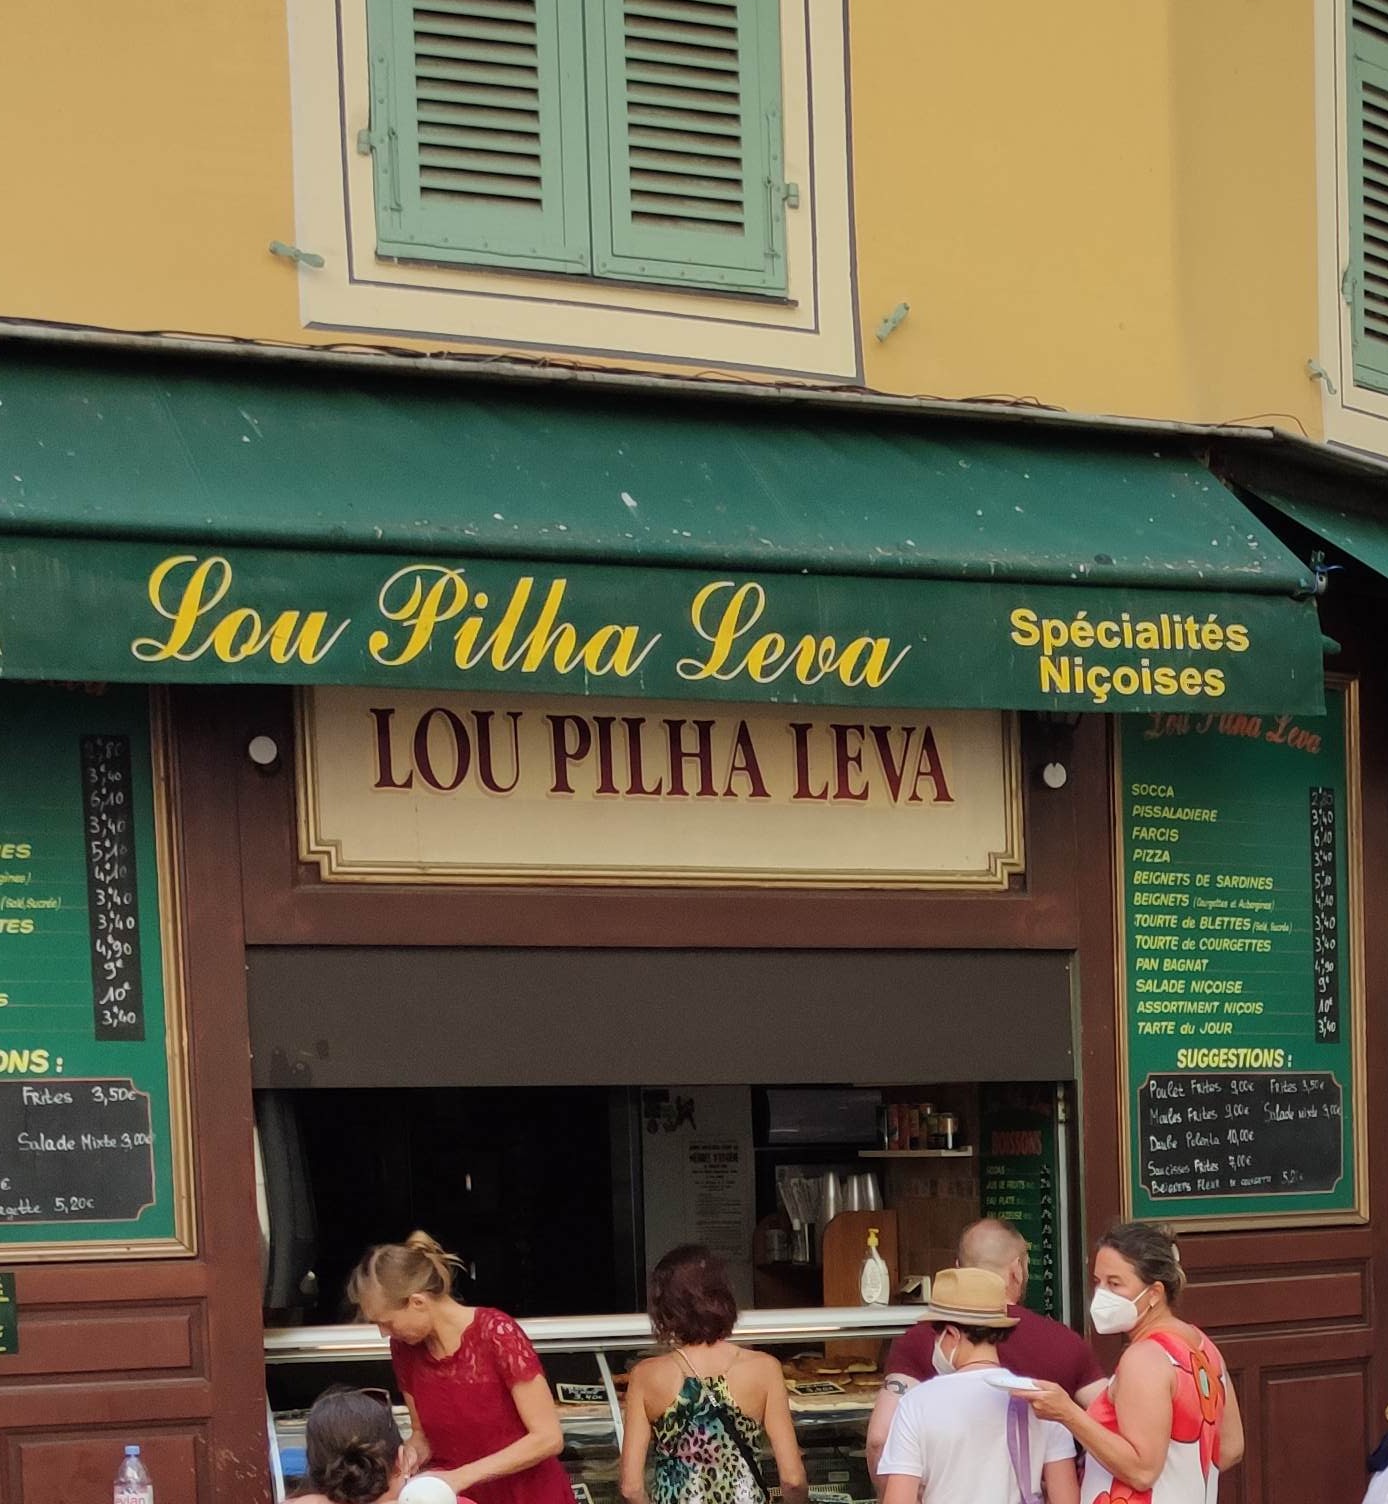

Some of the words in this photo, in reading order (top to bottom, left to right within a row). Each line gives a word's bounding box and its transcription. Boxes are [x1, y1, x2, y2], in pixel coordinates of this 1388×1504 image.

[131, 556, 350, 665] Lou
[369, 564, 661, 679] Pilha
[676, 581, 912, 688] Leva
[1010, 608, 1250, 655] Spécialités
[1039, 656, 1226, 704] Niçoises
[370, 707, 524, 793] LOU
[546, 715, 769, 800] PILHA
[790, 722, 956, 804] LEVA
[1131, 783, 1175, 798] SOCCA
[1132, 805, 1218, 823] PISSALADIERE
[1132, 826, 1179, 842] FARCIS
[1133, 849, 1171, 863] PIZZA
[1133, 870, 1190, 886] BEIGNETS
[1195, 874, 1210, 887] DE
[1216, 874, 1273, 891] SARDINES
[1133, 892, 1190, 907] BEIGNETS
[1134, 914, 1178, 929] TOURTE
[1182, 918, 1196, 929] de
[1199, 916, 1251, 931] BLETTES
[1135, 935, 1179, 951] TOURTE
[1181, 938, 1196, 951] de
[1199, 938, 1272, 952] COURGETTES
[1136, 958, 1159, 971] PAN
[1163, 958, 1208, 972] BAGNAT
[1136, 979, 1185, 994] SALADE
[1190, 981, 1243, 995] NIÇOISE
[1136, 1001, 1219, 1014] ASSORTIMENT
[1223, 1002, 1264, 1016] NIÇOIS
[1137, 1022, 1175, 1035] TARTE
[1180, 1022, 1195, 1034] du
[1199, 1022, 1233, 1034] JOUR
[1177, 1048, 1285, 1069] SUGGESTIONS
[91, 1086, 136, 1107] 3,50€
[1149, 1080, 1185, 1098] Poulet
[1149, 1108, 1183, 1125] Moules
[18, 1132, 76, 1152] Salade
[81, 1132, 117, 1150] Mixte
[53, 1196, 96, 1214] 5,20€
